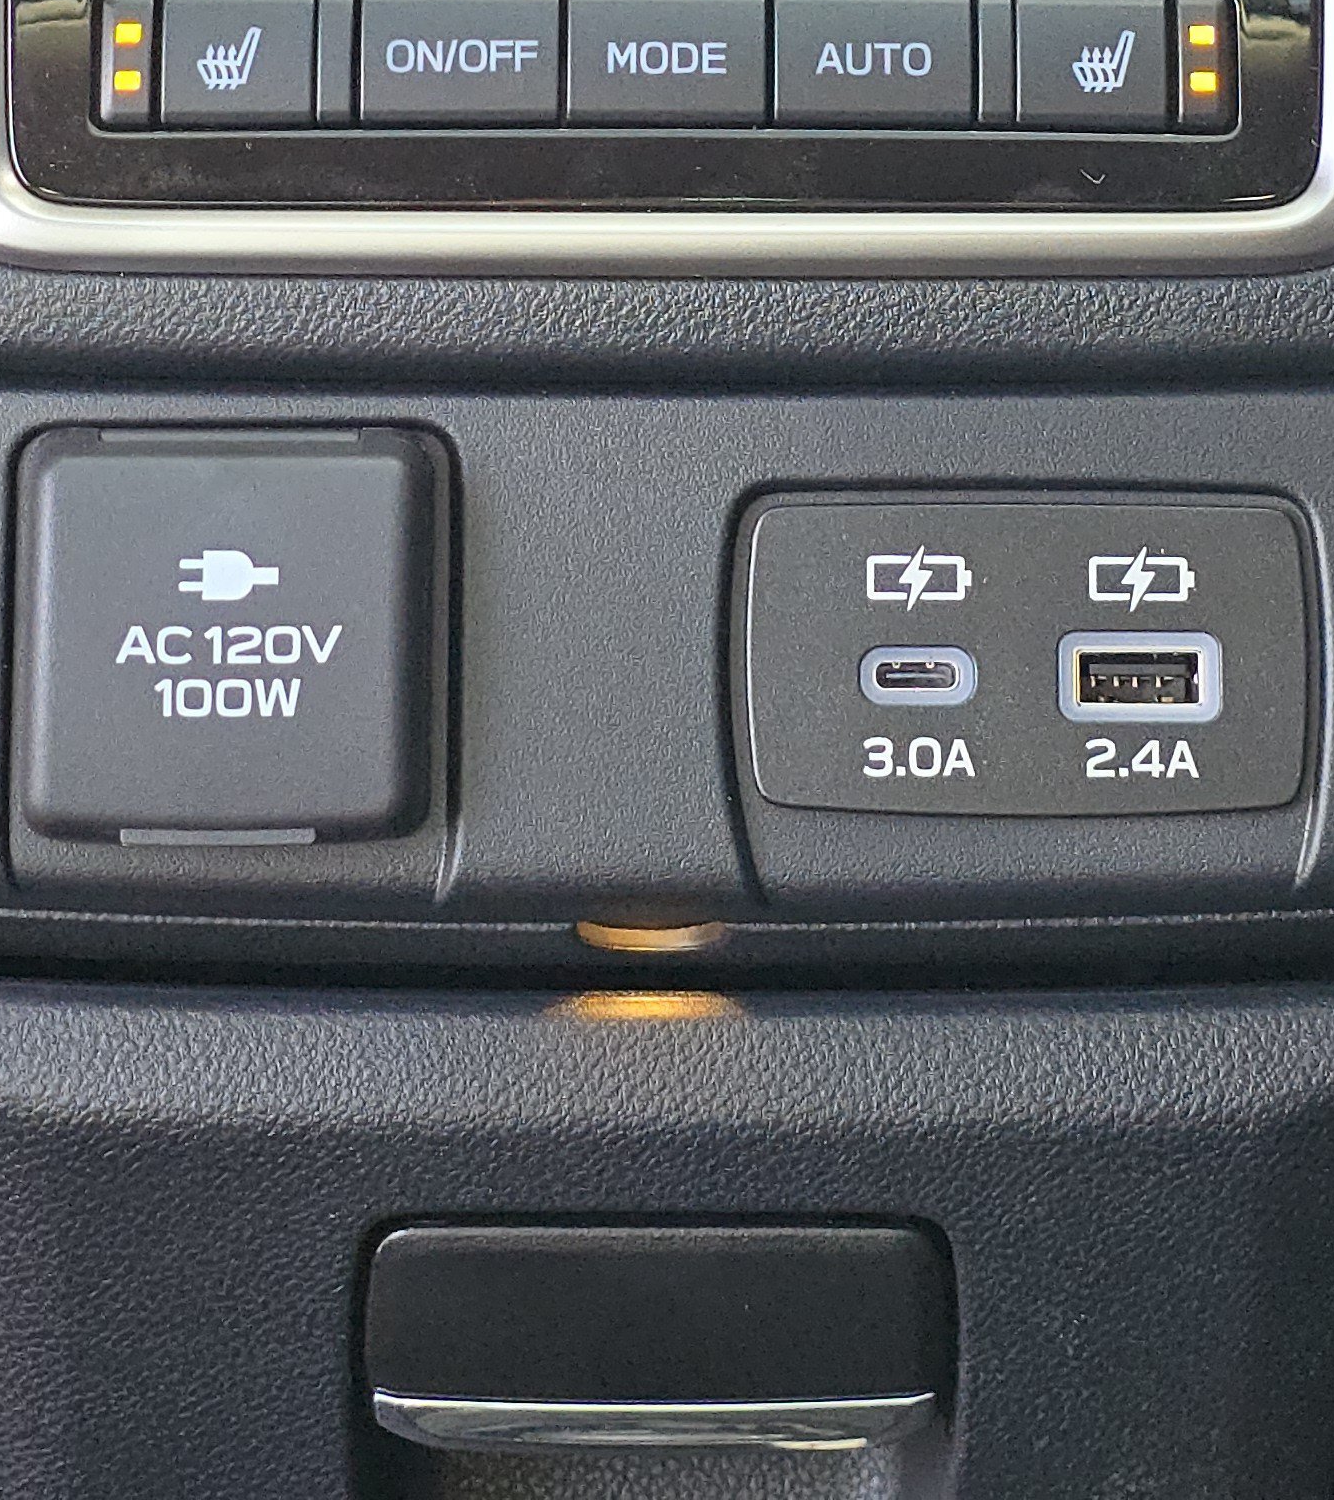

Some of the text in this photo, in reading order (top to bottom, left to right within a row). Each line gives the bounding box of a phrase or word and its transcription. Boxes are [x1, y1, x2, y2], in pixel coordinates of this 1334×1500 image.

[385, 38, 539, 74] ON/OFF
[606, 41, 728, 75] MODE
[814, 41, 933, 76] AUTO
[114, 624, 344, 665] AC 120V
[153, 678, 302, 718] 100W
[861, 736, 976, 779] 3.0A
[1084, 736, 1200, 780] 2.4A
